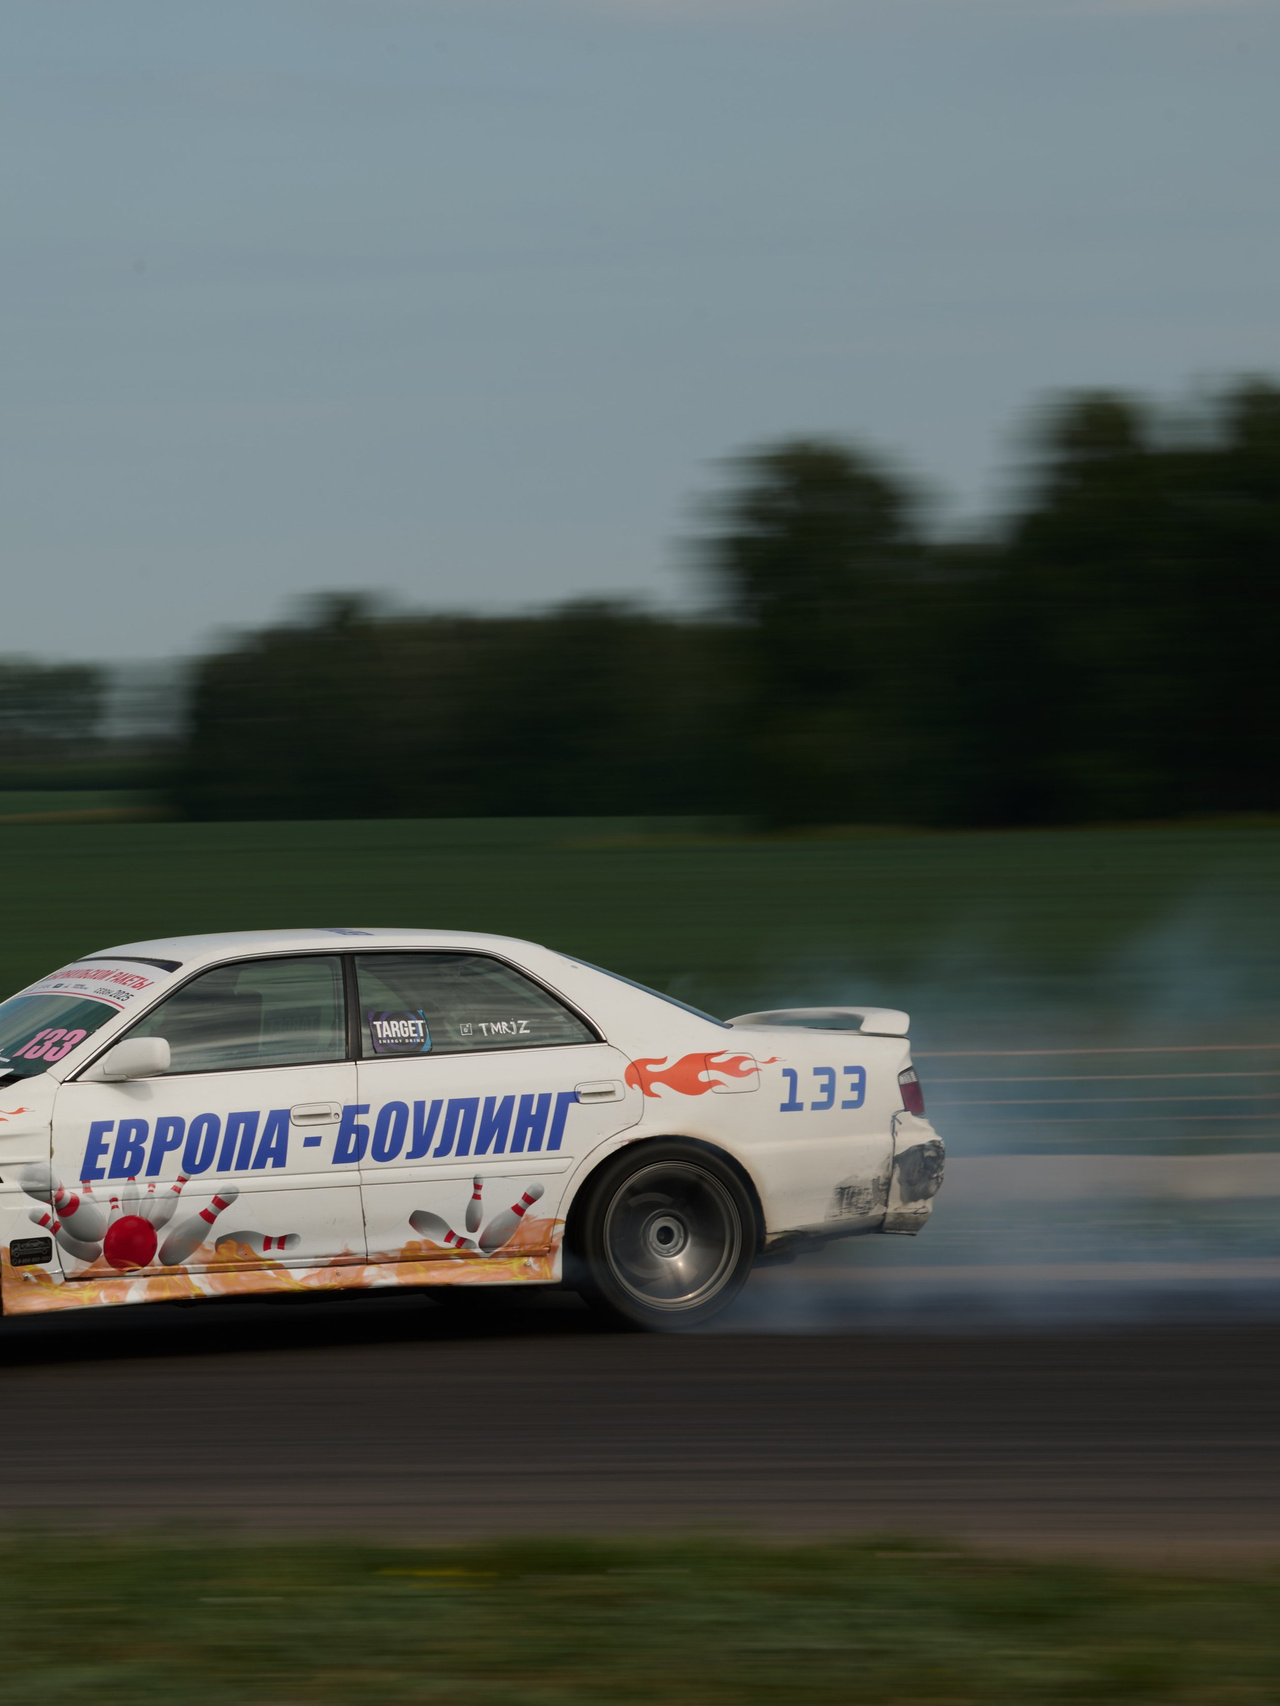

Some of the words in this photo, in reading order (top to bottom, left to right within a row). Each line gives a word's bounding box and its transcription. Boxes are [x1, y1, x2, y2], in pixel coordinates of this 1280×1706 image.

[104, 970, 155, 991] РАКЕТЫ
[109, 989, 135, 1002] 2025
[373, 1019, 425, 1039] TARGET
[12, 1027, 87, 1063] 133
[780, 1065, 867, 1112] 133
[79, 1108, 290, 1182] ЕВРОПА
[332, 1091, 582, 1165] БОУЛИНГ
